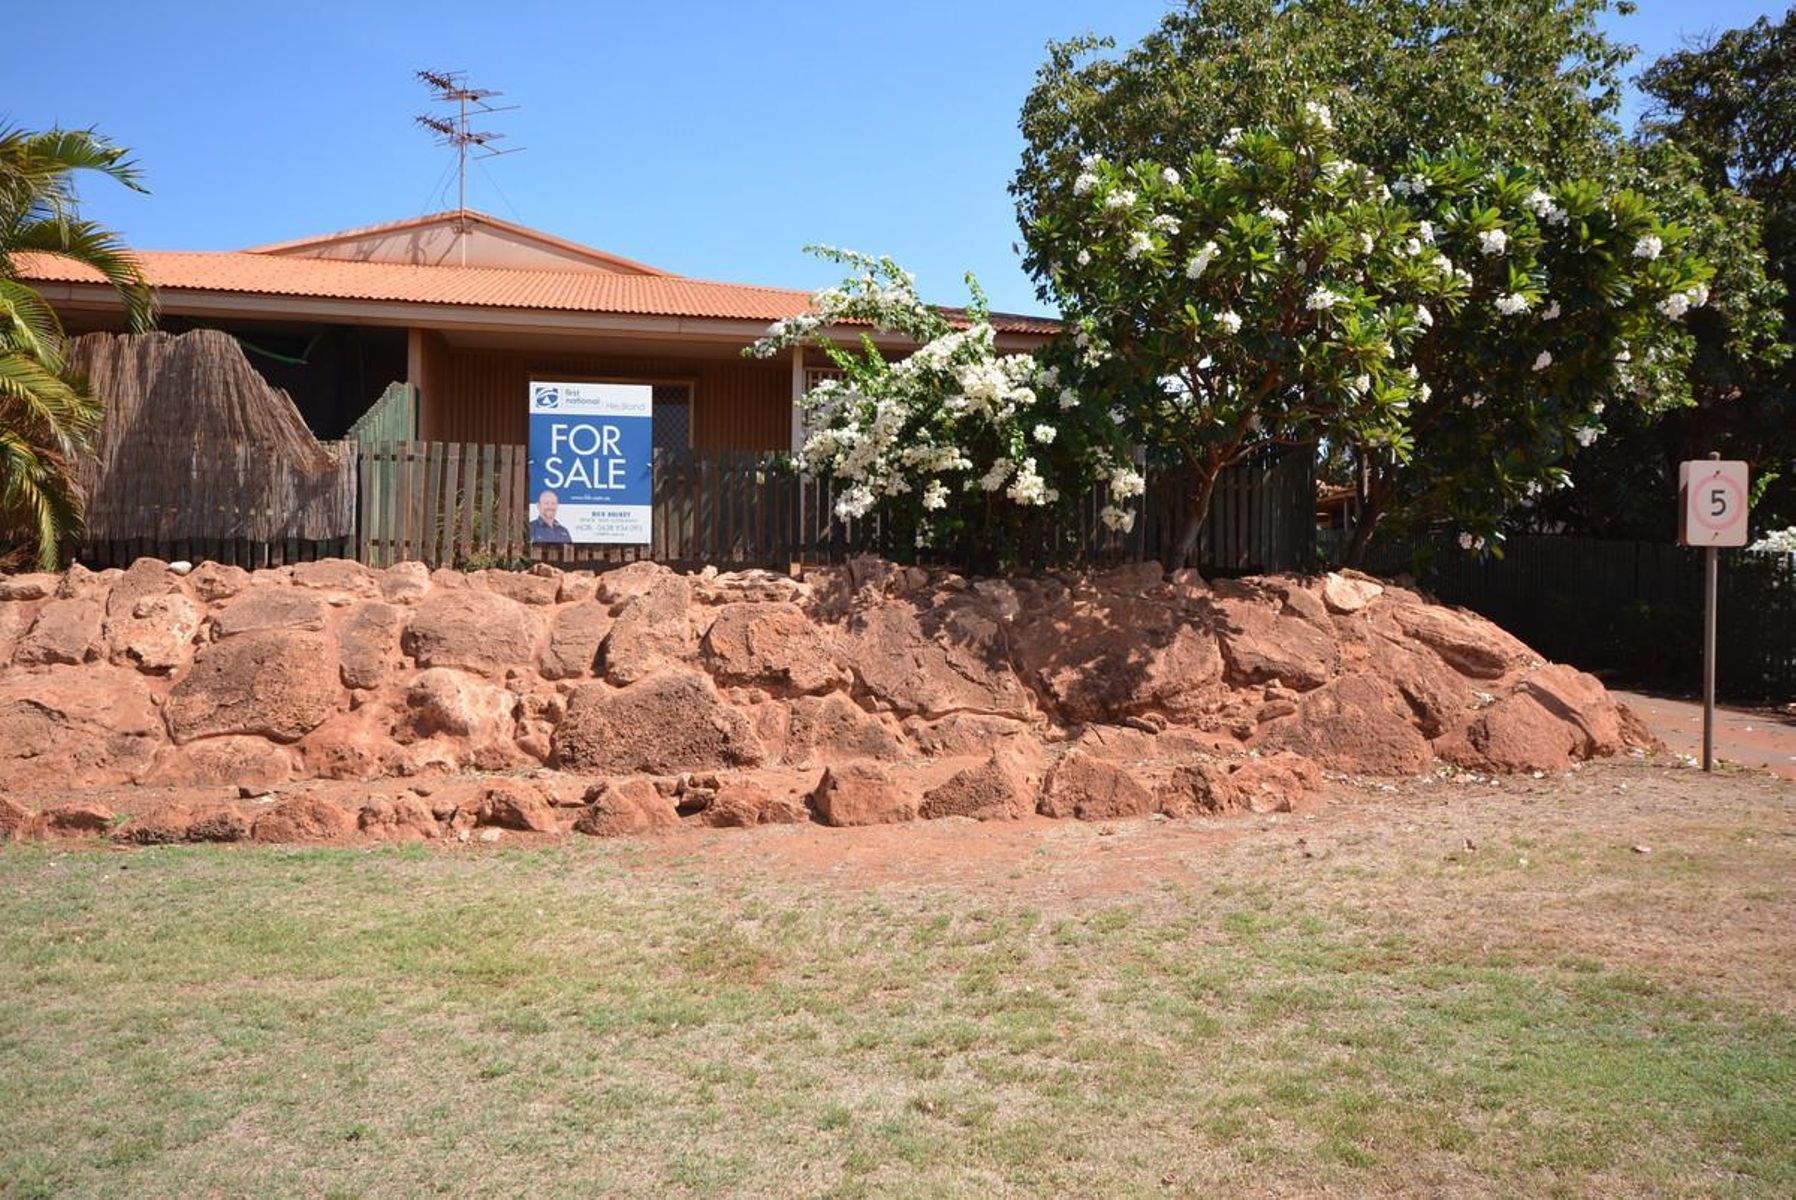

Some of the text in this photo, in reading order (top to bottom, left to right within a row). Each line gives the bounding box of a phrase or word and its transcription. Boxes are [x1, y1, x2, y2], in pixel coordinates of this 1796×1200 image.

[551, 424, 622, 456] FOR
[544, 457, 627, 489] SALE
[1711, 489, 1727, 517] 5
